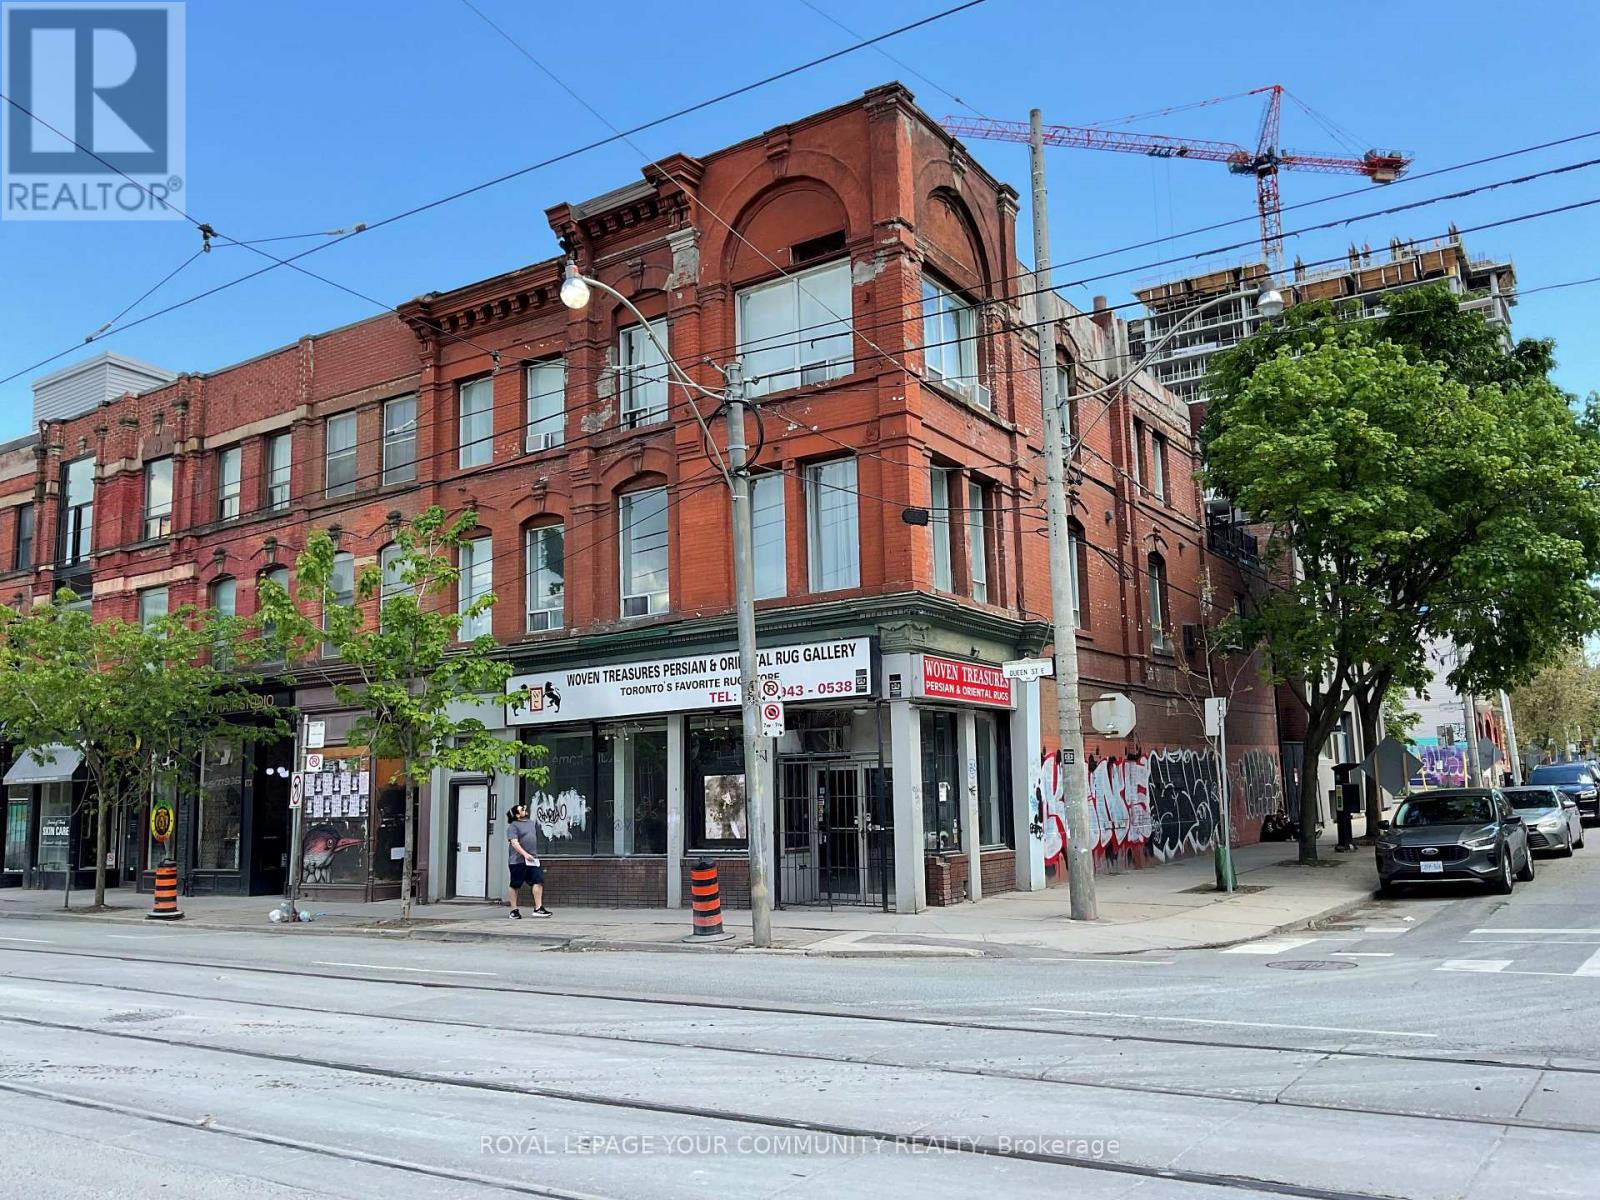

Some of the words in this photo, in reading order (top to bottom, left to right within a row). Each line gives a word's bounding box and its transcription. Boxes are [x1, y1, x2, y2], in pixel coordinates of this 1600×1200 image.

[567, 670, 600, 687] WOVEN
[603, 665, 660, 683] TREASURES
[663, 659, 706, 677] PERSIAN
[709, 658, 717, 672] &
[720, 653, 773, 670] ORIAL
[776, 650, 799, 665] RUG
[803, 643, 856, 662] GALLERY
[925, 660, 958, 680] WOVEN
[962, 667, 1009, 688] TREASURES
[1009, 669, 1028, 677] QUEEN
[621, 681, 672, 696] TORONTO'S
[675, 678, 720, 692] FAVORITE
[709, 692, 737, 703] TEL:
[818, 681, 853, 695] 0538
[926, 681, 954, 693] PERSIAN
[956, 685, 960, 694] &
[962, 687, 992, 699] ORIENTAL
[993, 690, 1009, 701] RUGS
[42, 826, 55, 836] SKIN
[56, 826, 70, 836] CARE
